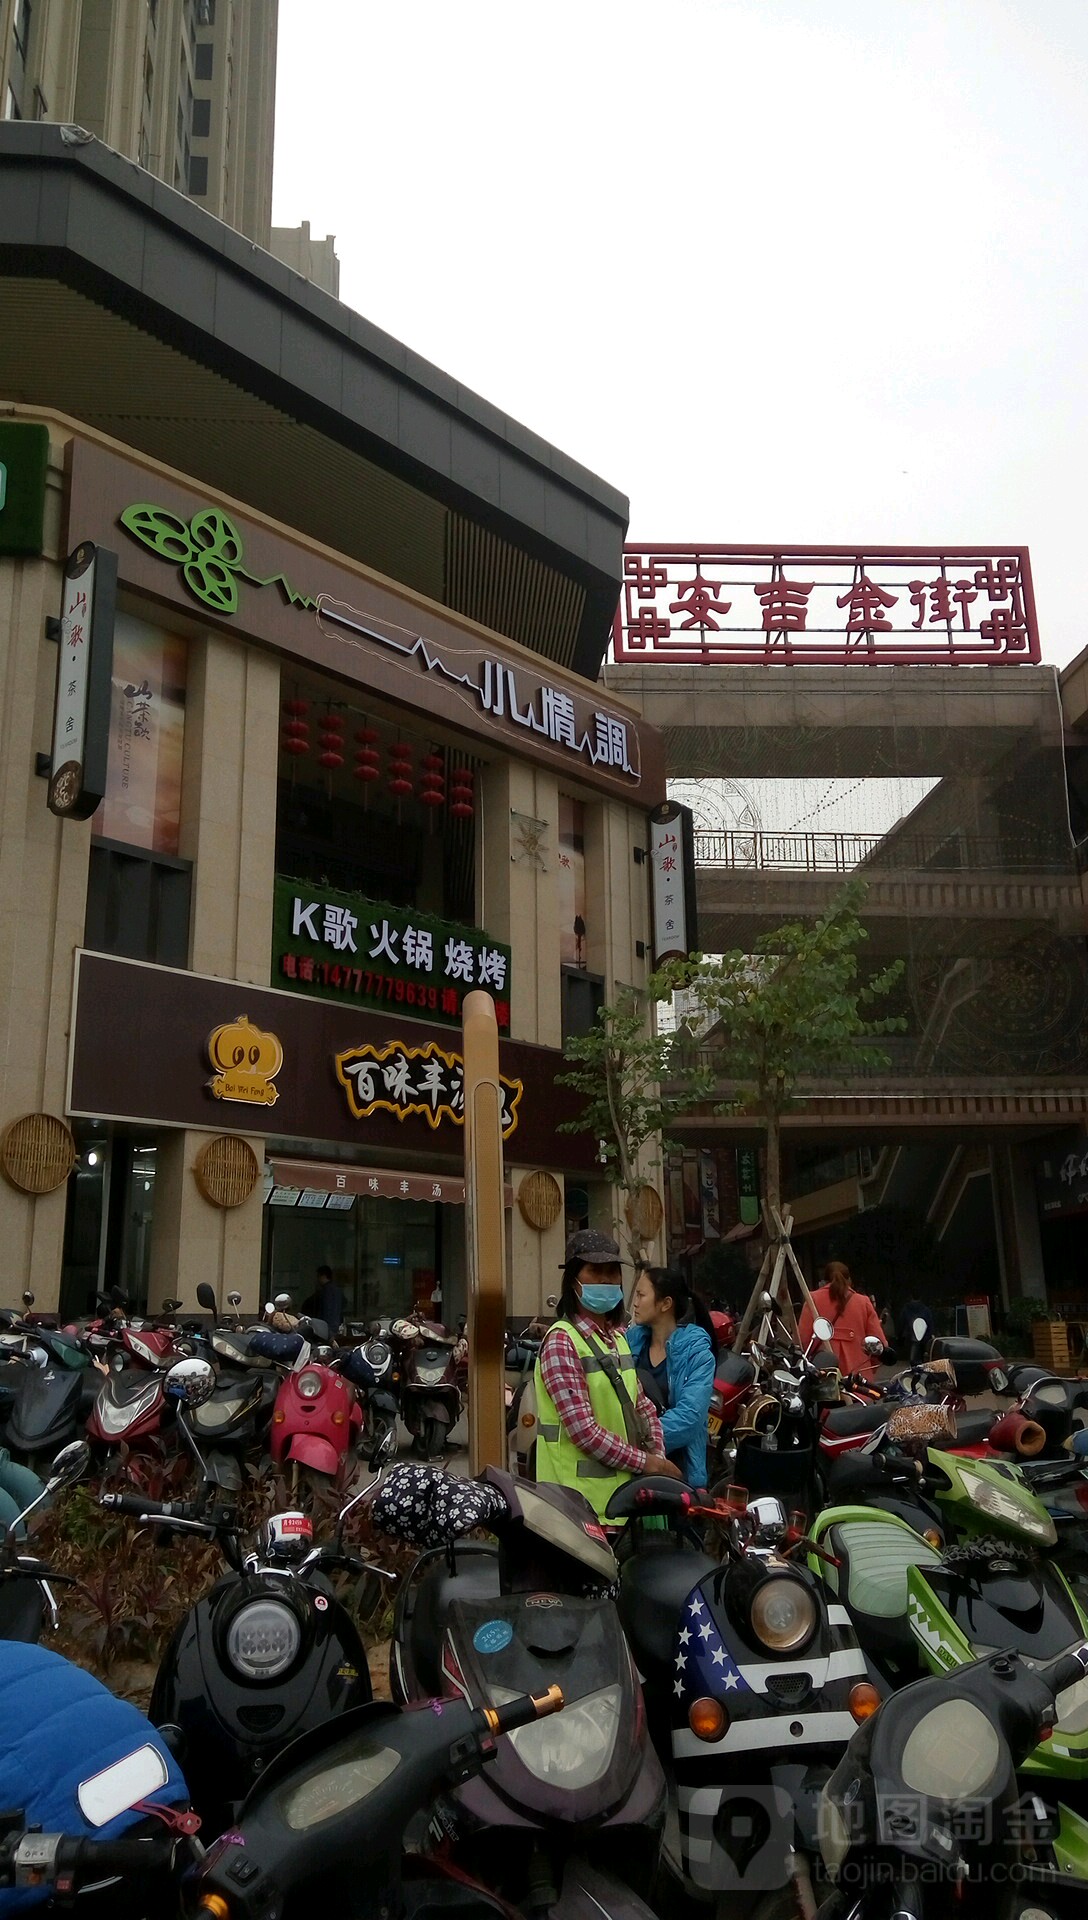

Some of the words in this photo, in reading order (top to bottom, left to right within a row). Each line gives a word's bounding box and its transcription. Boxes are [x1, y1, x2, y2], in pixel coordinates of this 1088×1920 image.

[669, 575, 979, 632] 安吉金街
[343, 1053, 512, 1124] 百味丰
[335, 1174, 466, 1198] 百味丰汤
